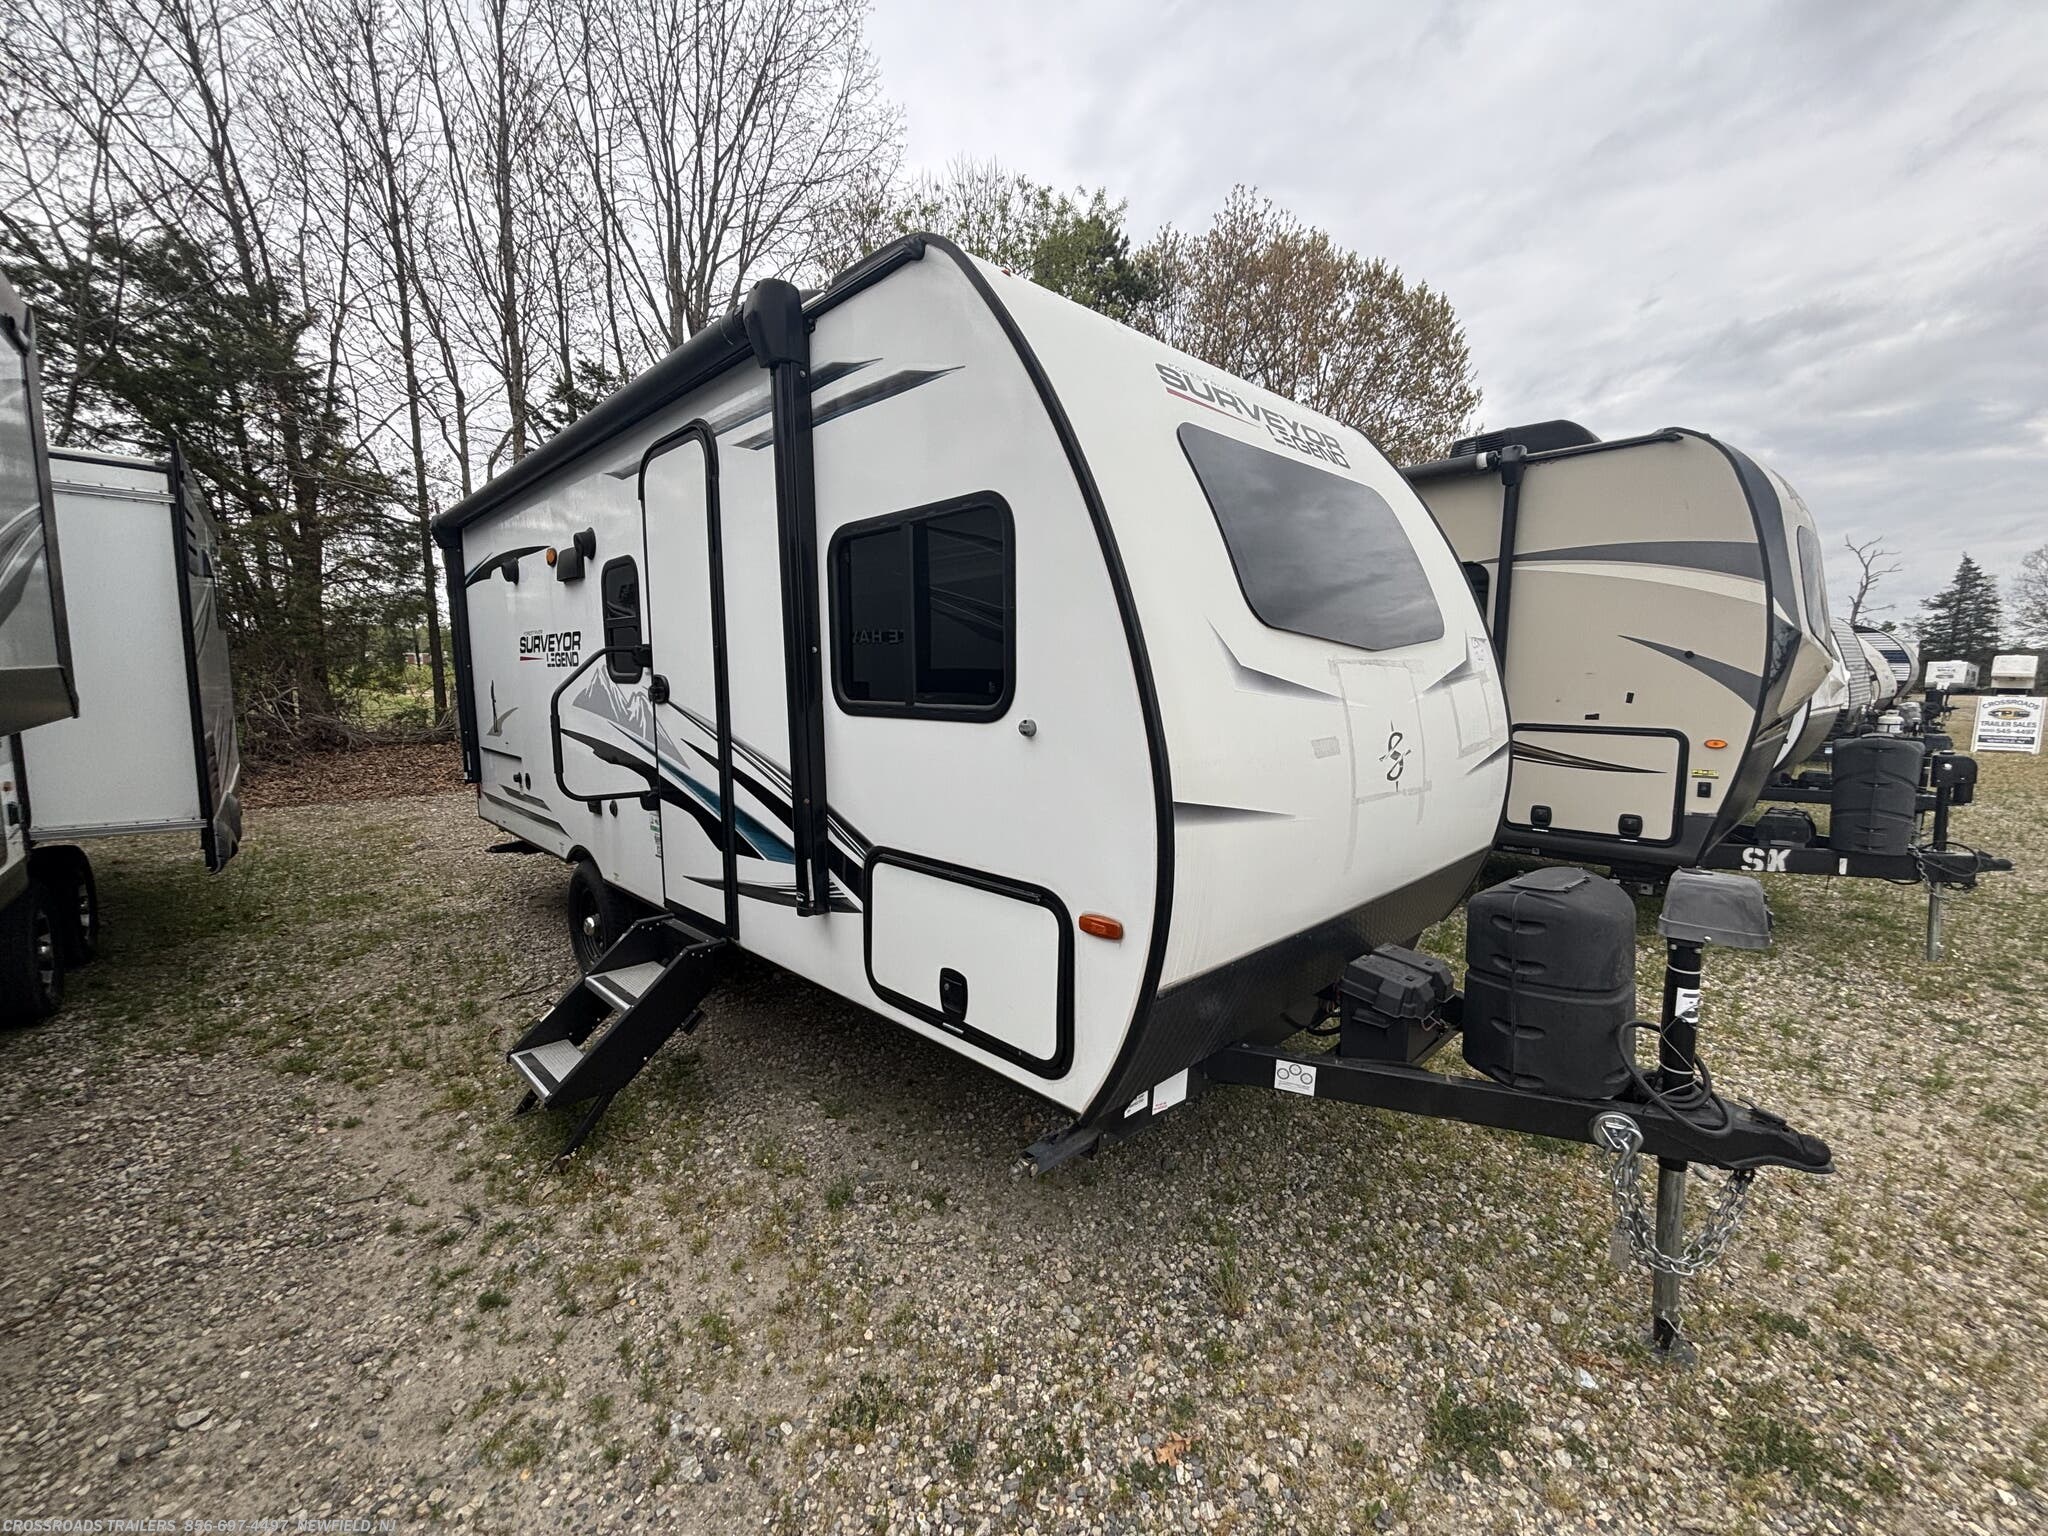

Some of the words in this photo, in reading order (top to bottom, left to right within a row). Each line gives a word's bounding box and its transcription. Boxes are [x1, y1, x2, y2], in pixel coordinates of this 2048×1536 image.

[1155, 363, 1345, 455] SURVEYOR
[1266, 424, 1351, 469] LEGEND
[520, 631, 581, 653] SURVEYOR
[546, 651, 579, 667] LEGEND
[1982, 699, 2040, 710] CROSSROADS
